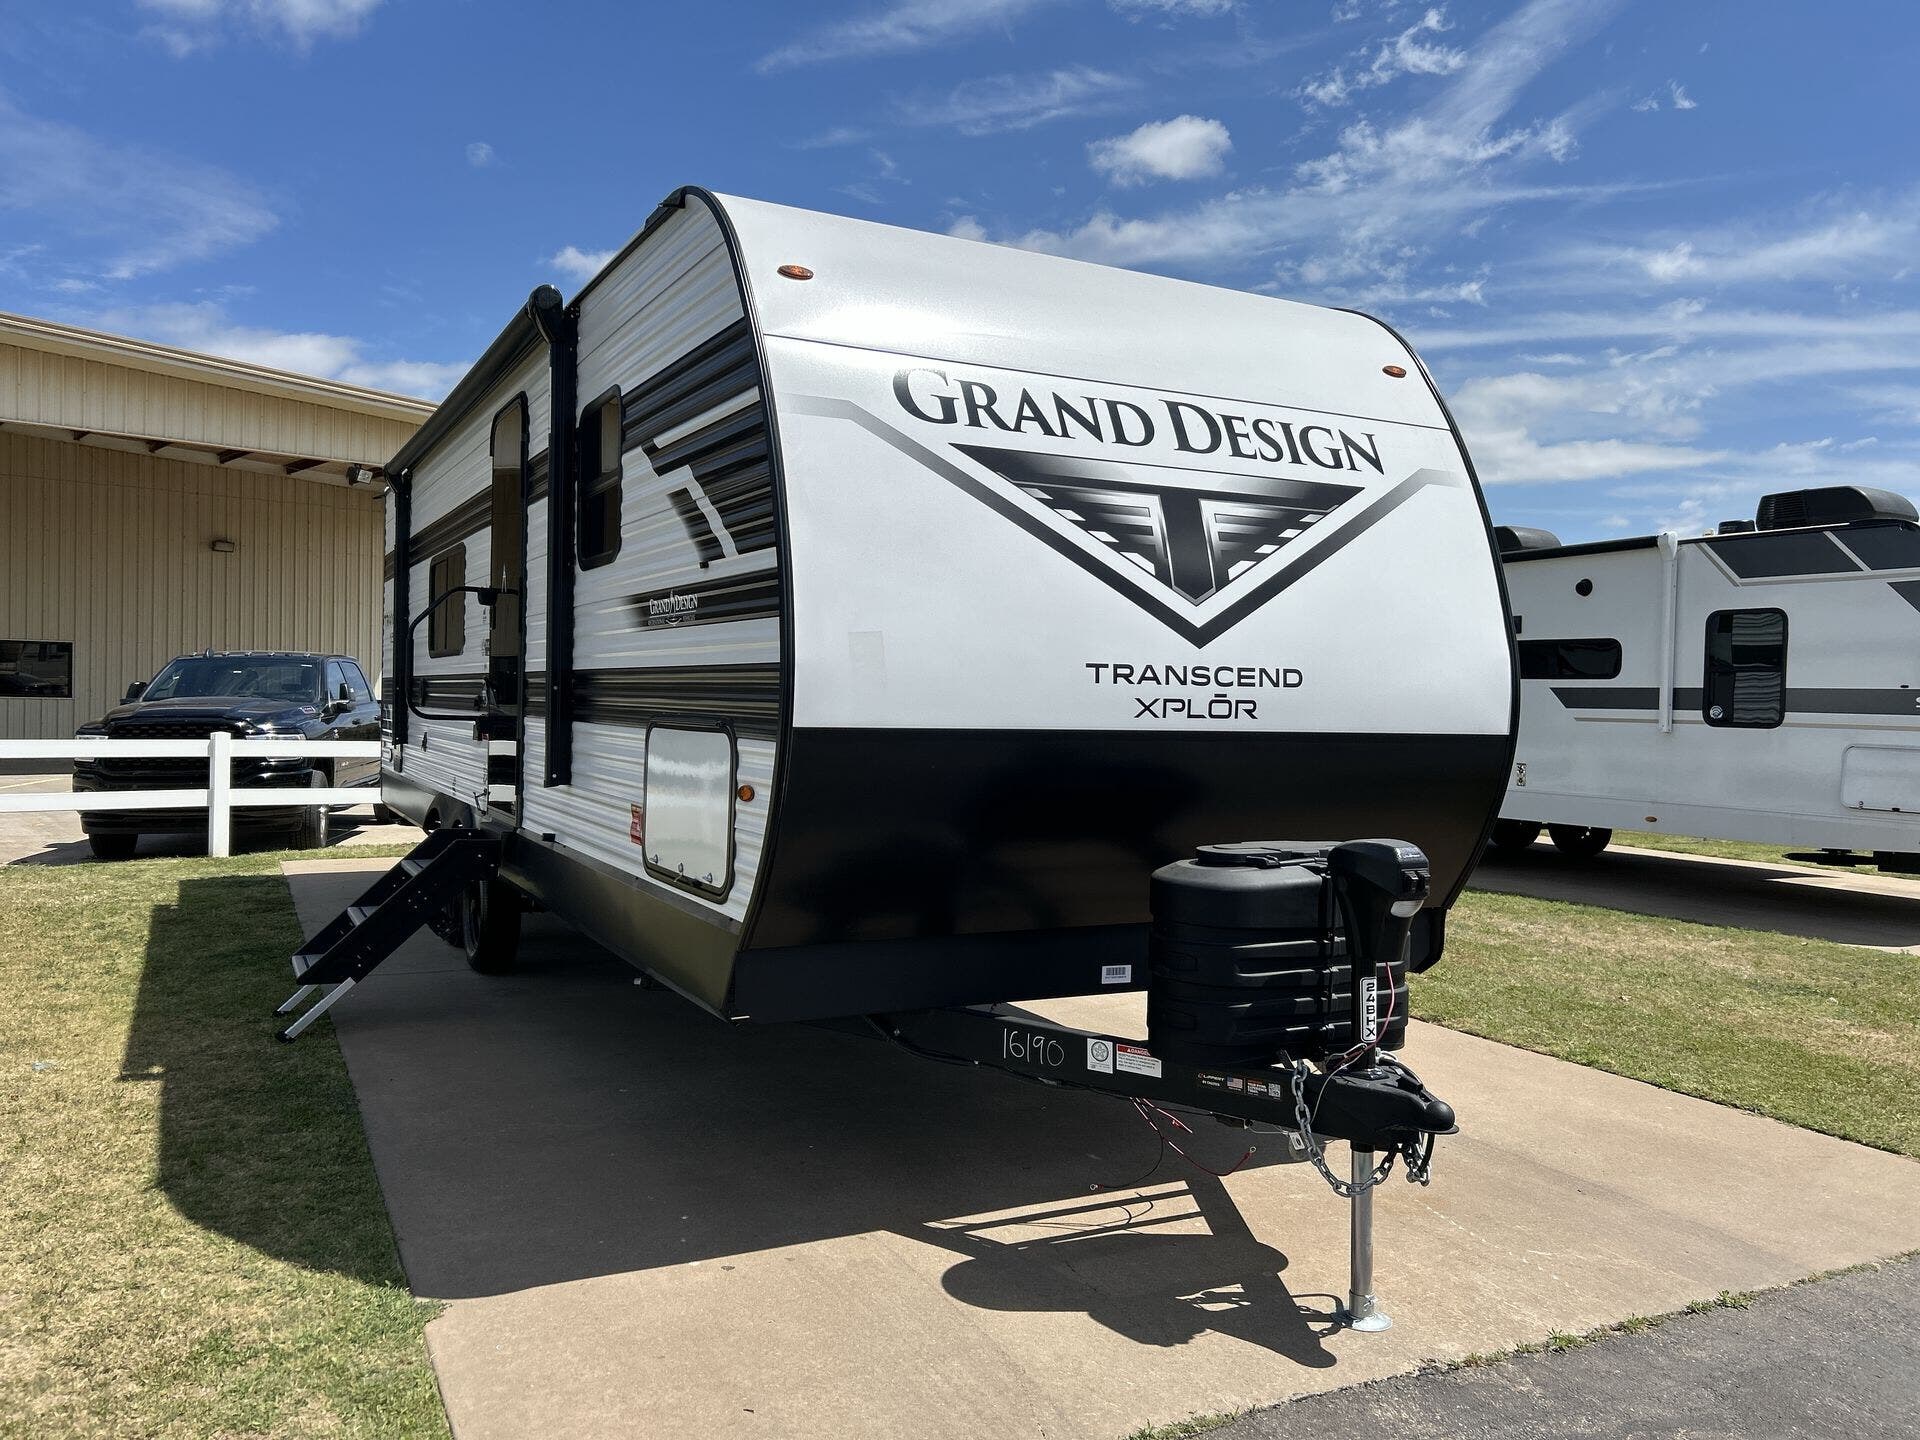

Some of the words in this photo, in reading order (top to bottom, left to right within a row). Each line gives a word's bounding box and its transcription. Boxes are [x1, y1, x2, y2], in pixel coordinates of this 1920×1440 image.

[892, 368, 1155, 446] GRAND
[1158, 398, 1386, 476] DESIGN
[649, 599, 671, 614] GRAND
[673, 594, 698, 611] DESIGN
[1085, 662, 1304, 689] TRANSCEND
[1365, 982, 1377, 1038] 24BHX
[1003, 1027, 1065, 1067] 16190
